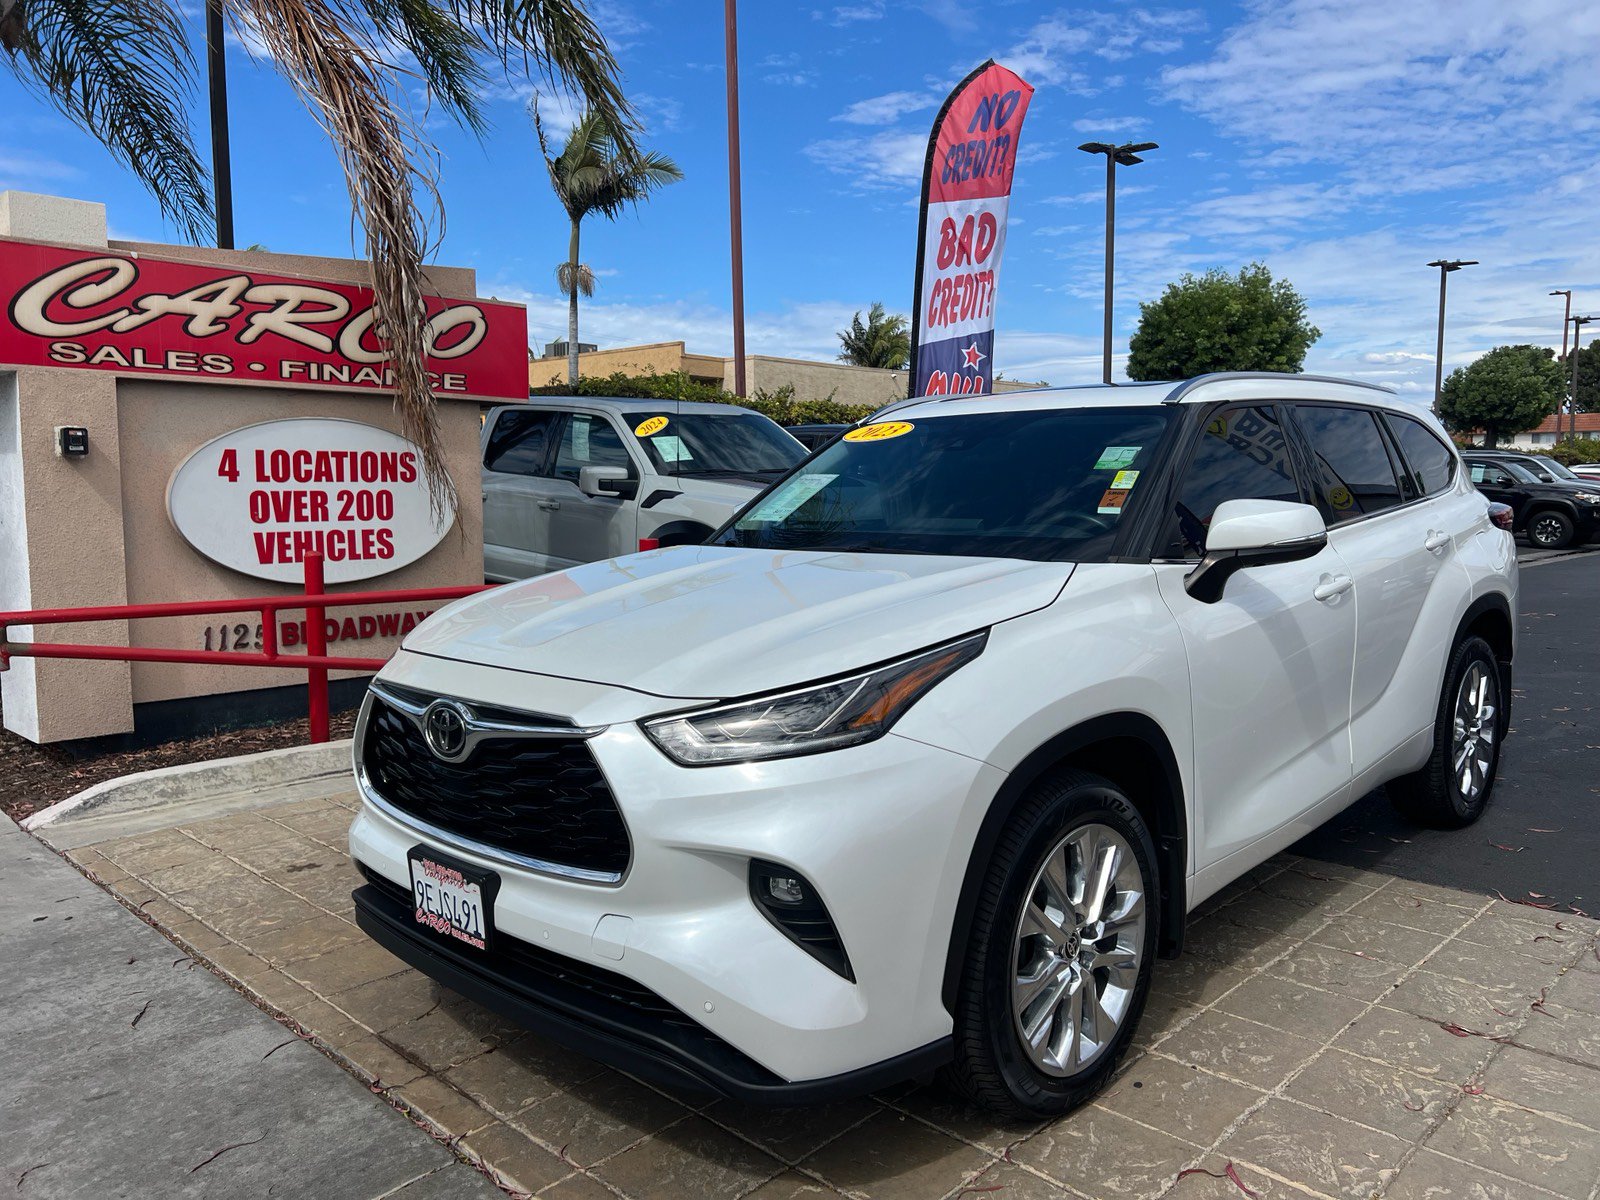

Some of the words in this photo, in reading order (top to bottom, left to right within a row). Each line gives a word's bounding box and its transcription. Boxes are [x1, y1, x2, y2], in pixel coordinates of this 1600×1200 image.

[968, 90, 1022, 134] NO
[942, 134, 1011, 186] CREDIT?
[936, 211, 998, 271] BAD
[928, 269, 994, 329] CREDIT?
[49, 341, 237, 375] SALES
[640, 417, 664, 435] 2024
[217, 448, 240, 483] 4
[255, 449, 417, 484] LOCATIONS
[249, 490, 329, 523] OVER
[336, 490, 394, 522] 200
[253, 528, 395, 565] VEHICLES
[416, 879, 482, 938] 9EJS491
